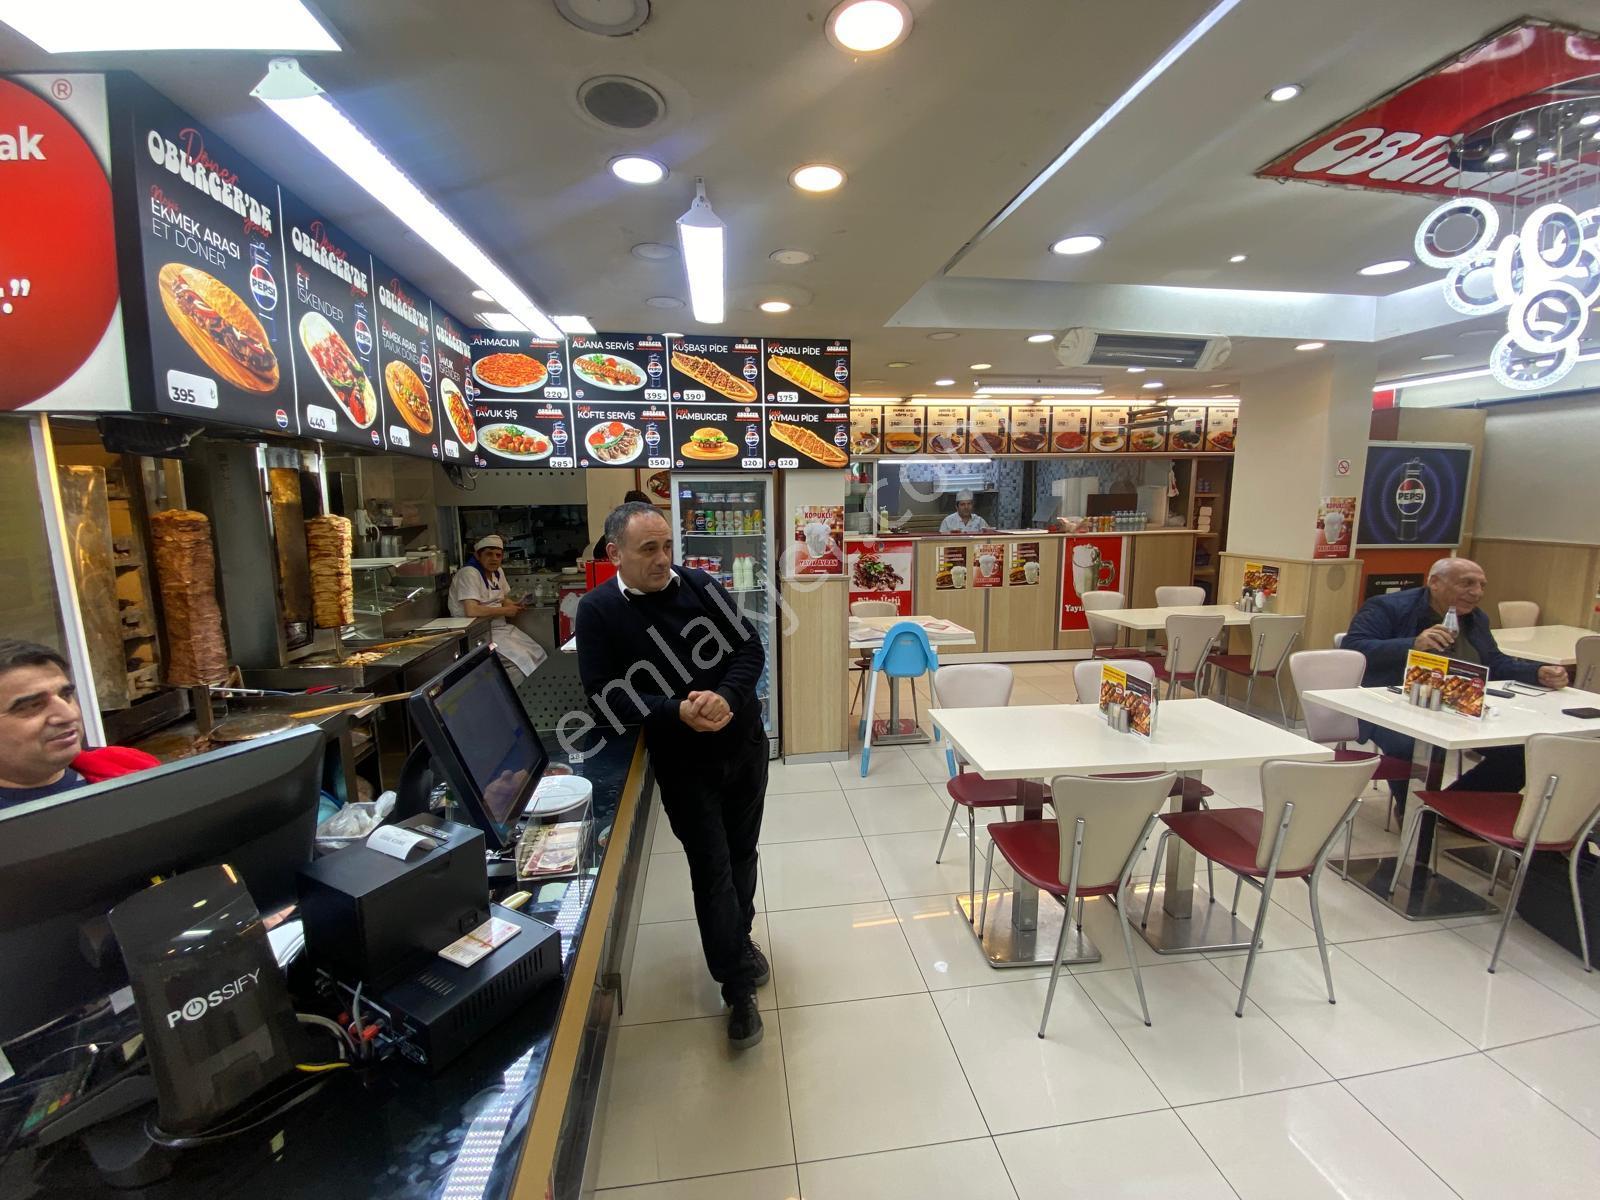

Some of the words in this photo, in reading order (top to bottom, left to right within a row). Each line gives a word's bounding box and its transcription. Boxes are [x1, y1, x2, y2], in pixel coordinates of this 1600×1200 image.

[151, 197, 201, 239] EKMEK
[204, 228, 240, 260] ARASI
[152, 218, 170, 240] ET
[296, 272, 310, 290] ET
[252, 279, 275, 297] PEPSI
[572, 341, 604, 349] ADANA
[605, 341, 634, 350] SERVİS
[672, 344, 708, 354] KUŞBAŞI
[709, 344, 728, 353] PİDE
[767, 346, 800, 355] KAŞARLI
[802, 346, 821, 355] PİDE
[171, 386, 196, 403] 395
[545, 391, 562, 399] 220
[646, 392, 662, 400] 395
[778, 394, 794, 402] 375
[504, 408, 518, 420] ŞİŞ
[606, 410, 636, 420] SERVİS
[676, 412, 728, 421] HAMBURGER
[769, 414, 799, 422] KIYMALI
[801, 413, 819, 422] PİDE
[309, 417, 326, 429] 440
[552, 460, 568, 468] 285
[1397, 492, 1424, 501] PEPSI
[167, 968, 261, 1029] POSSIFY
